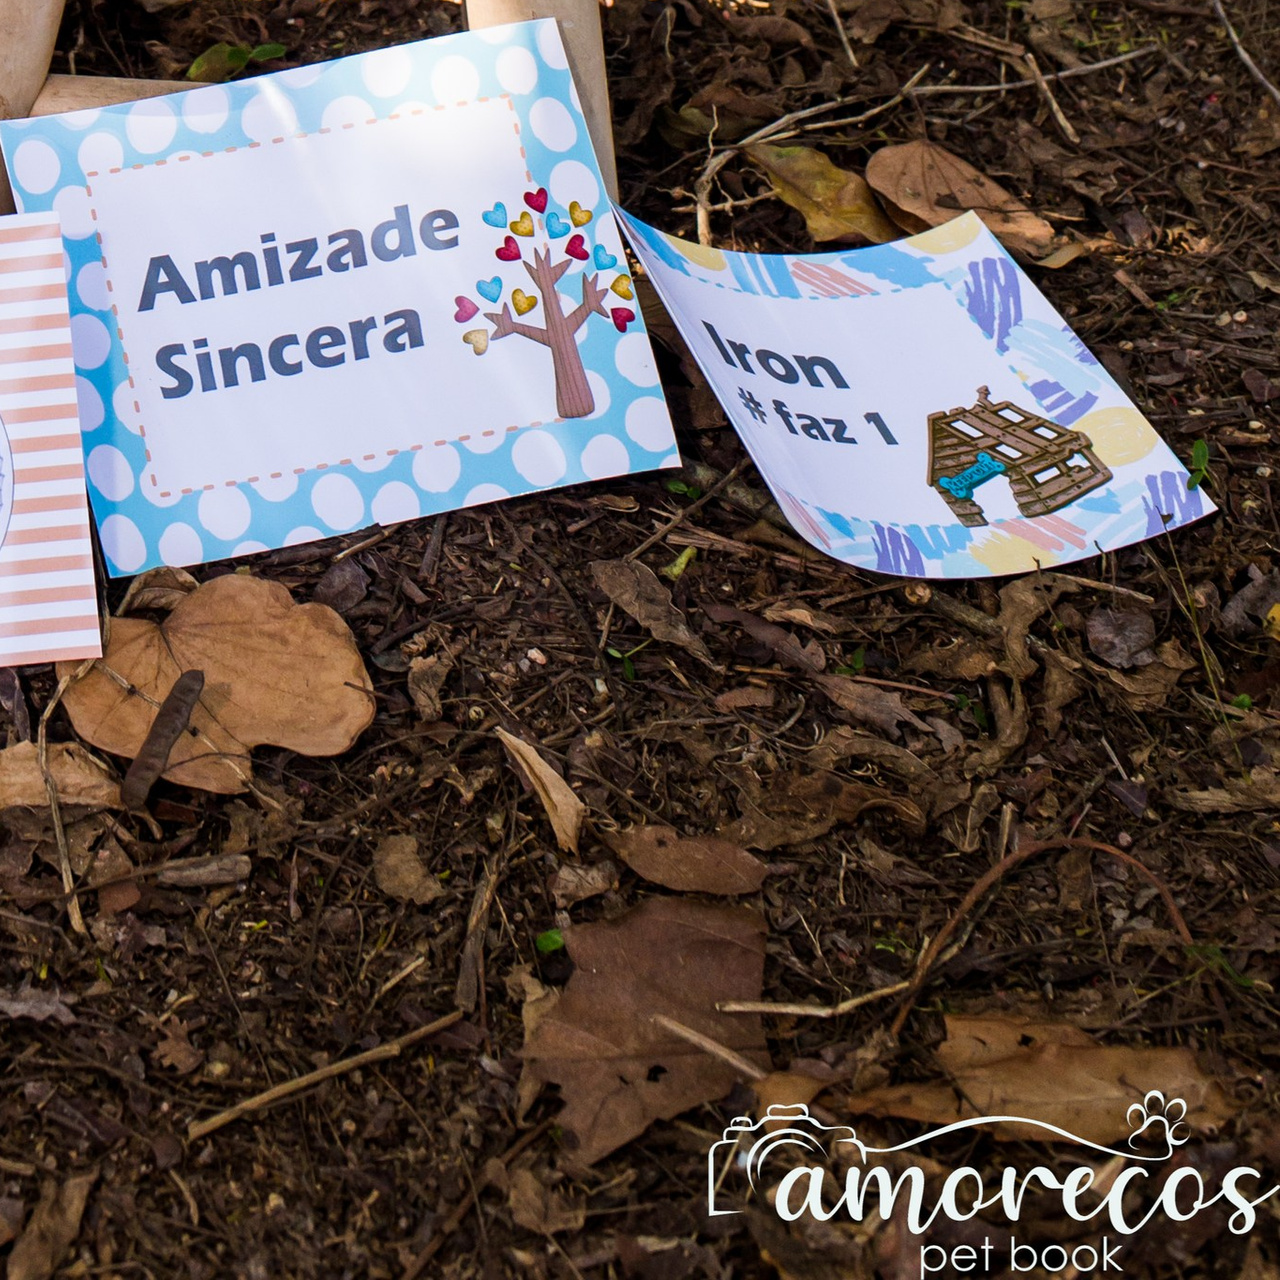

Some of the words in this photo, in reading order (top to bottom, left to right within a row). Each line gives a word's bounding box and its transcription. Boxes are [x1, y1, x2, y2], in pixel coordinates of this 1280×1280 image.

[137, 203, 460, 313] Amizade
[154, 307, 425, 400] Sincera
[701, 319, 851, 390] Iron
[737, 386, 768, 425] #
[772, 398, 859, 445] faz
[863, 411, 900, 446] 1
